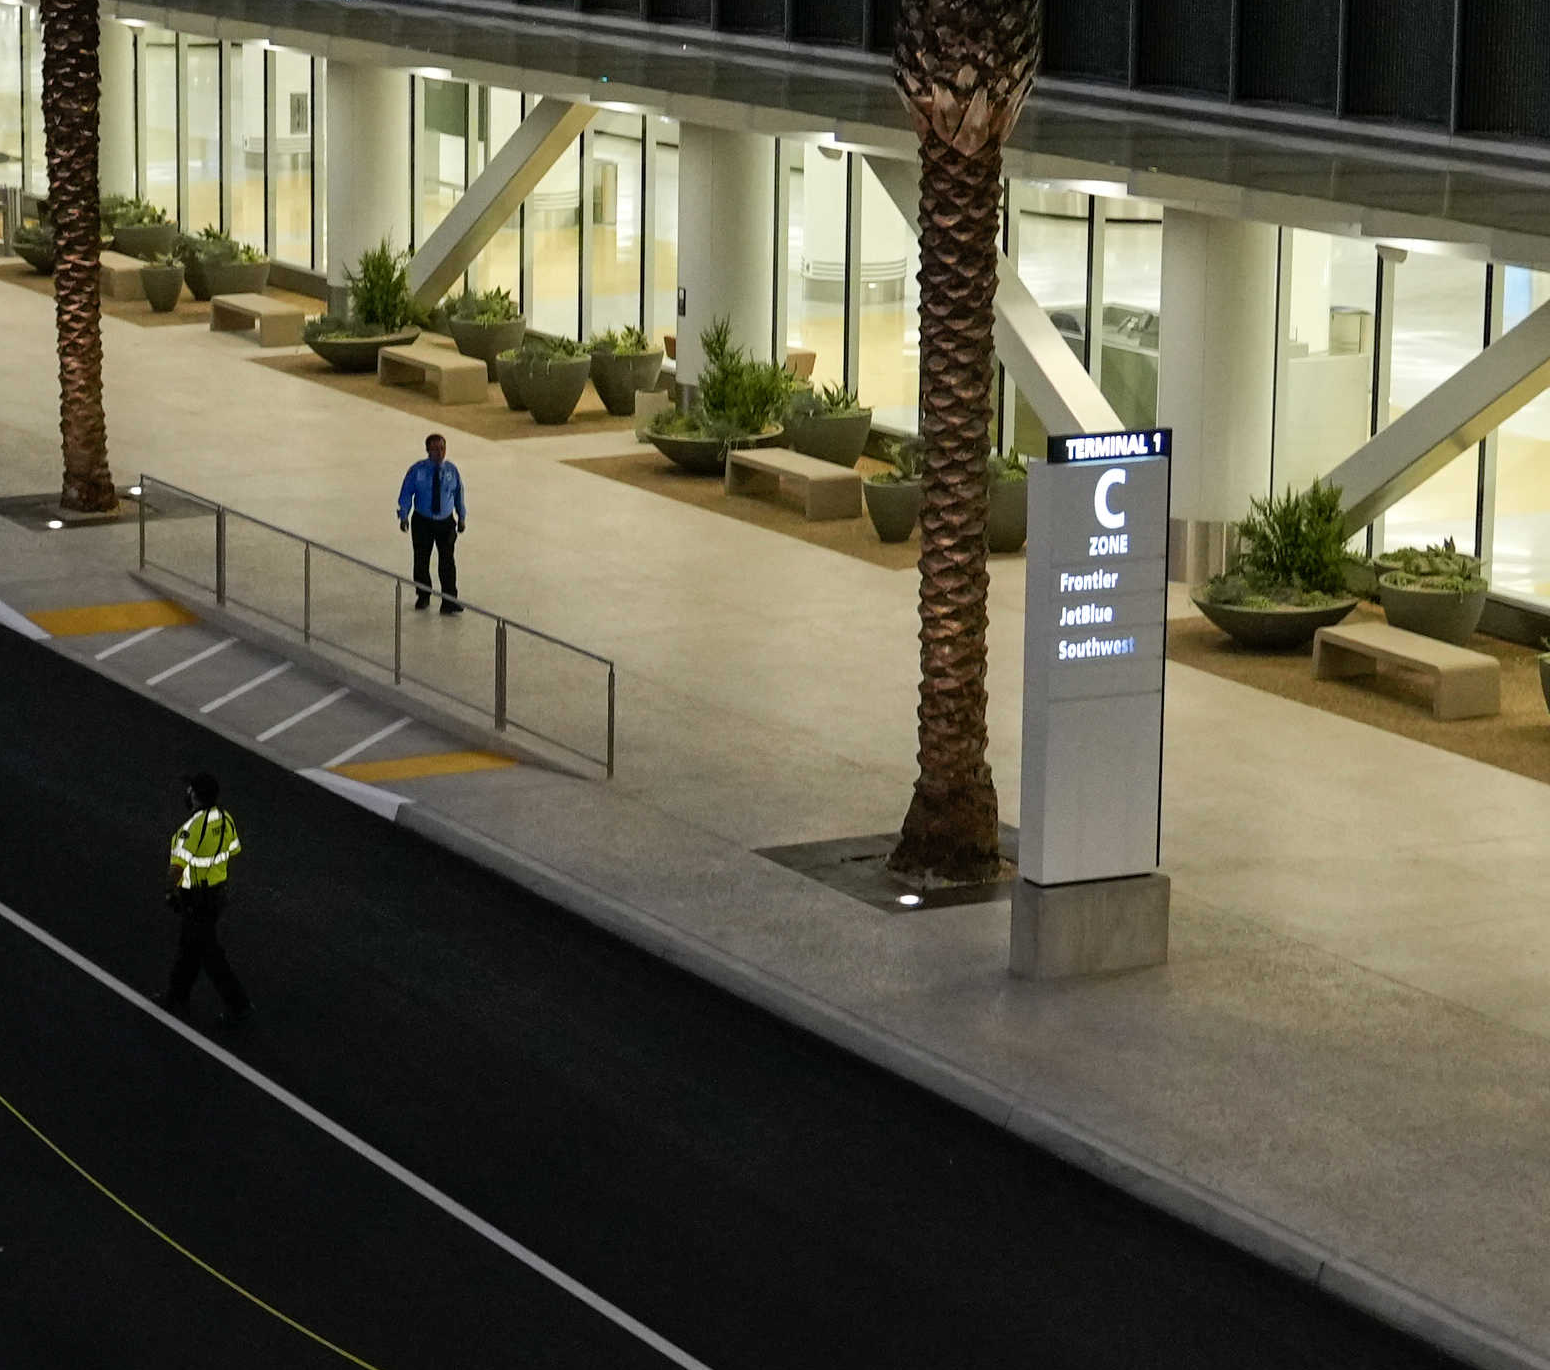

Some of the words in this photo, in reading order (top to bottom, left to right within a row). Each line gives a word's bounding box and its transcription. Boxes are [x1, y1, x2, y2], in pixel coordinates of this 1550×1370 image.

[1066, 434, 1149, 460] TERMINAL
[1153, 433, 1162, 453] 1
[1094, 468, 1127, 529] C
[1089, 535, 1128, 556] ZONE
[1060, 569, 1118, 592] Frontier
[1059, 603, 1113, 626] JetBlue
[1058, 637, 1135, 660] Southwest
